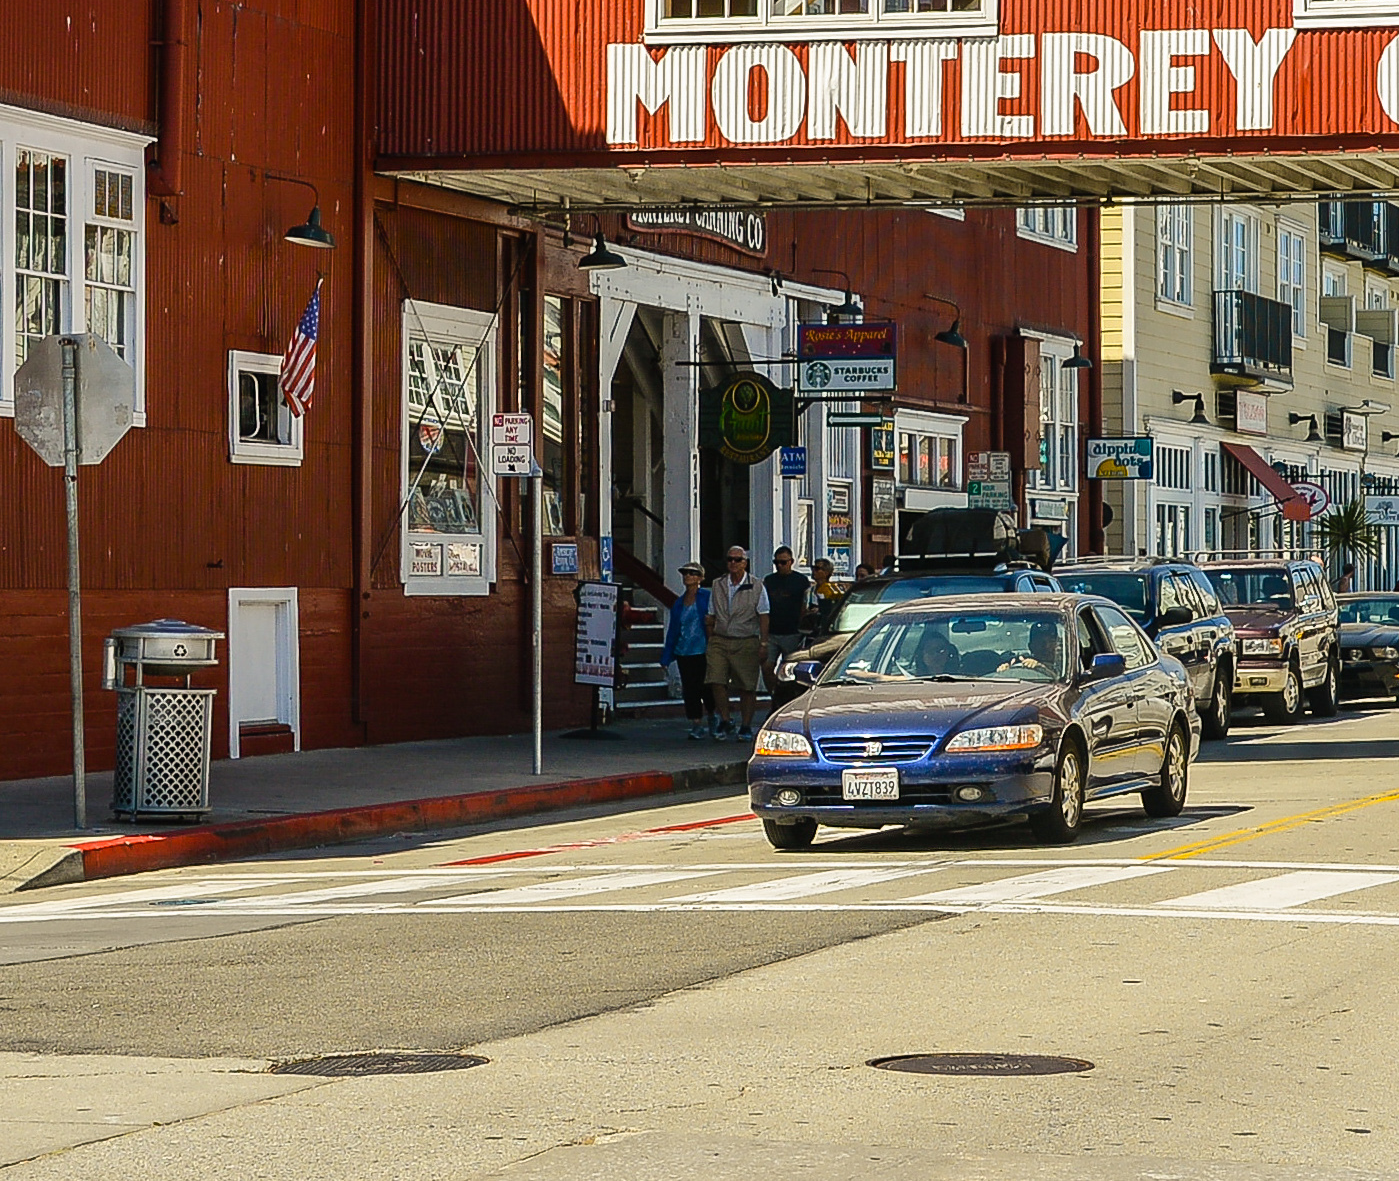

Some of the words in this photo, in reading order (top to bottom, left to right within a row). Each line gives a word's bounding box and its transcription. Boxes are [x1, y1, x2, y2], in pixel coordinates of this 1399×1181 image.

[605, 27, 1299, 146] MONTEREY
[805, 329, 841, 343] Rosie's
[845, 328, 887, 343] Apparel
[833, 366, 889, 375] STARBUCKS
[843, 375, 879, 383] COFFEE
[506, 426, 518, 434] ANY
[508, 447, 516, 455] NO
[498, 455, 525, 464] LOADING
[782, 453, 804, 462] ATM
[1114, 456, 1143, 467] dots
[973, 483, 978, 494] 2
